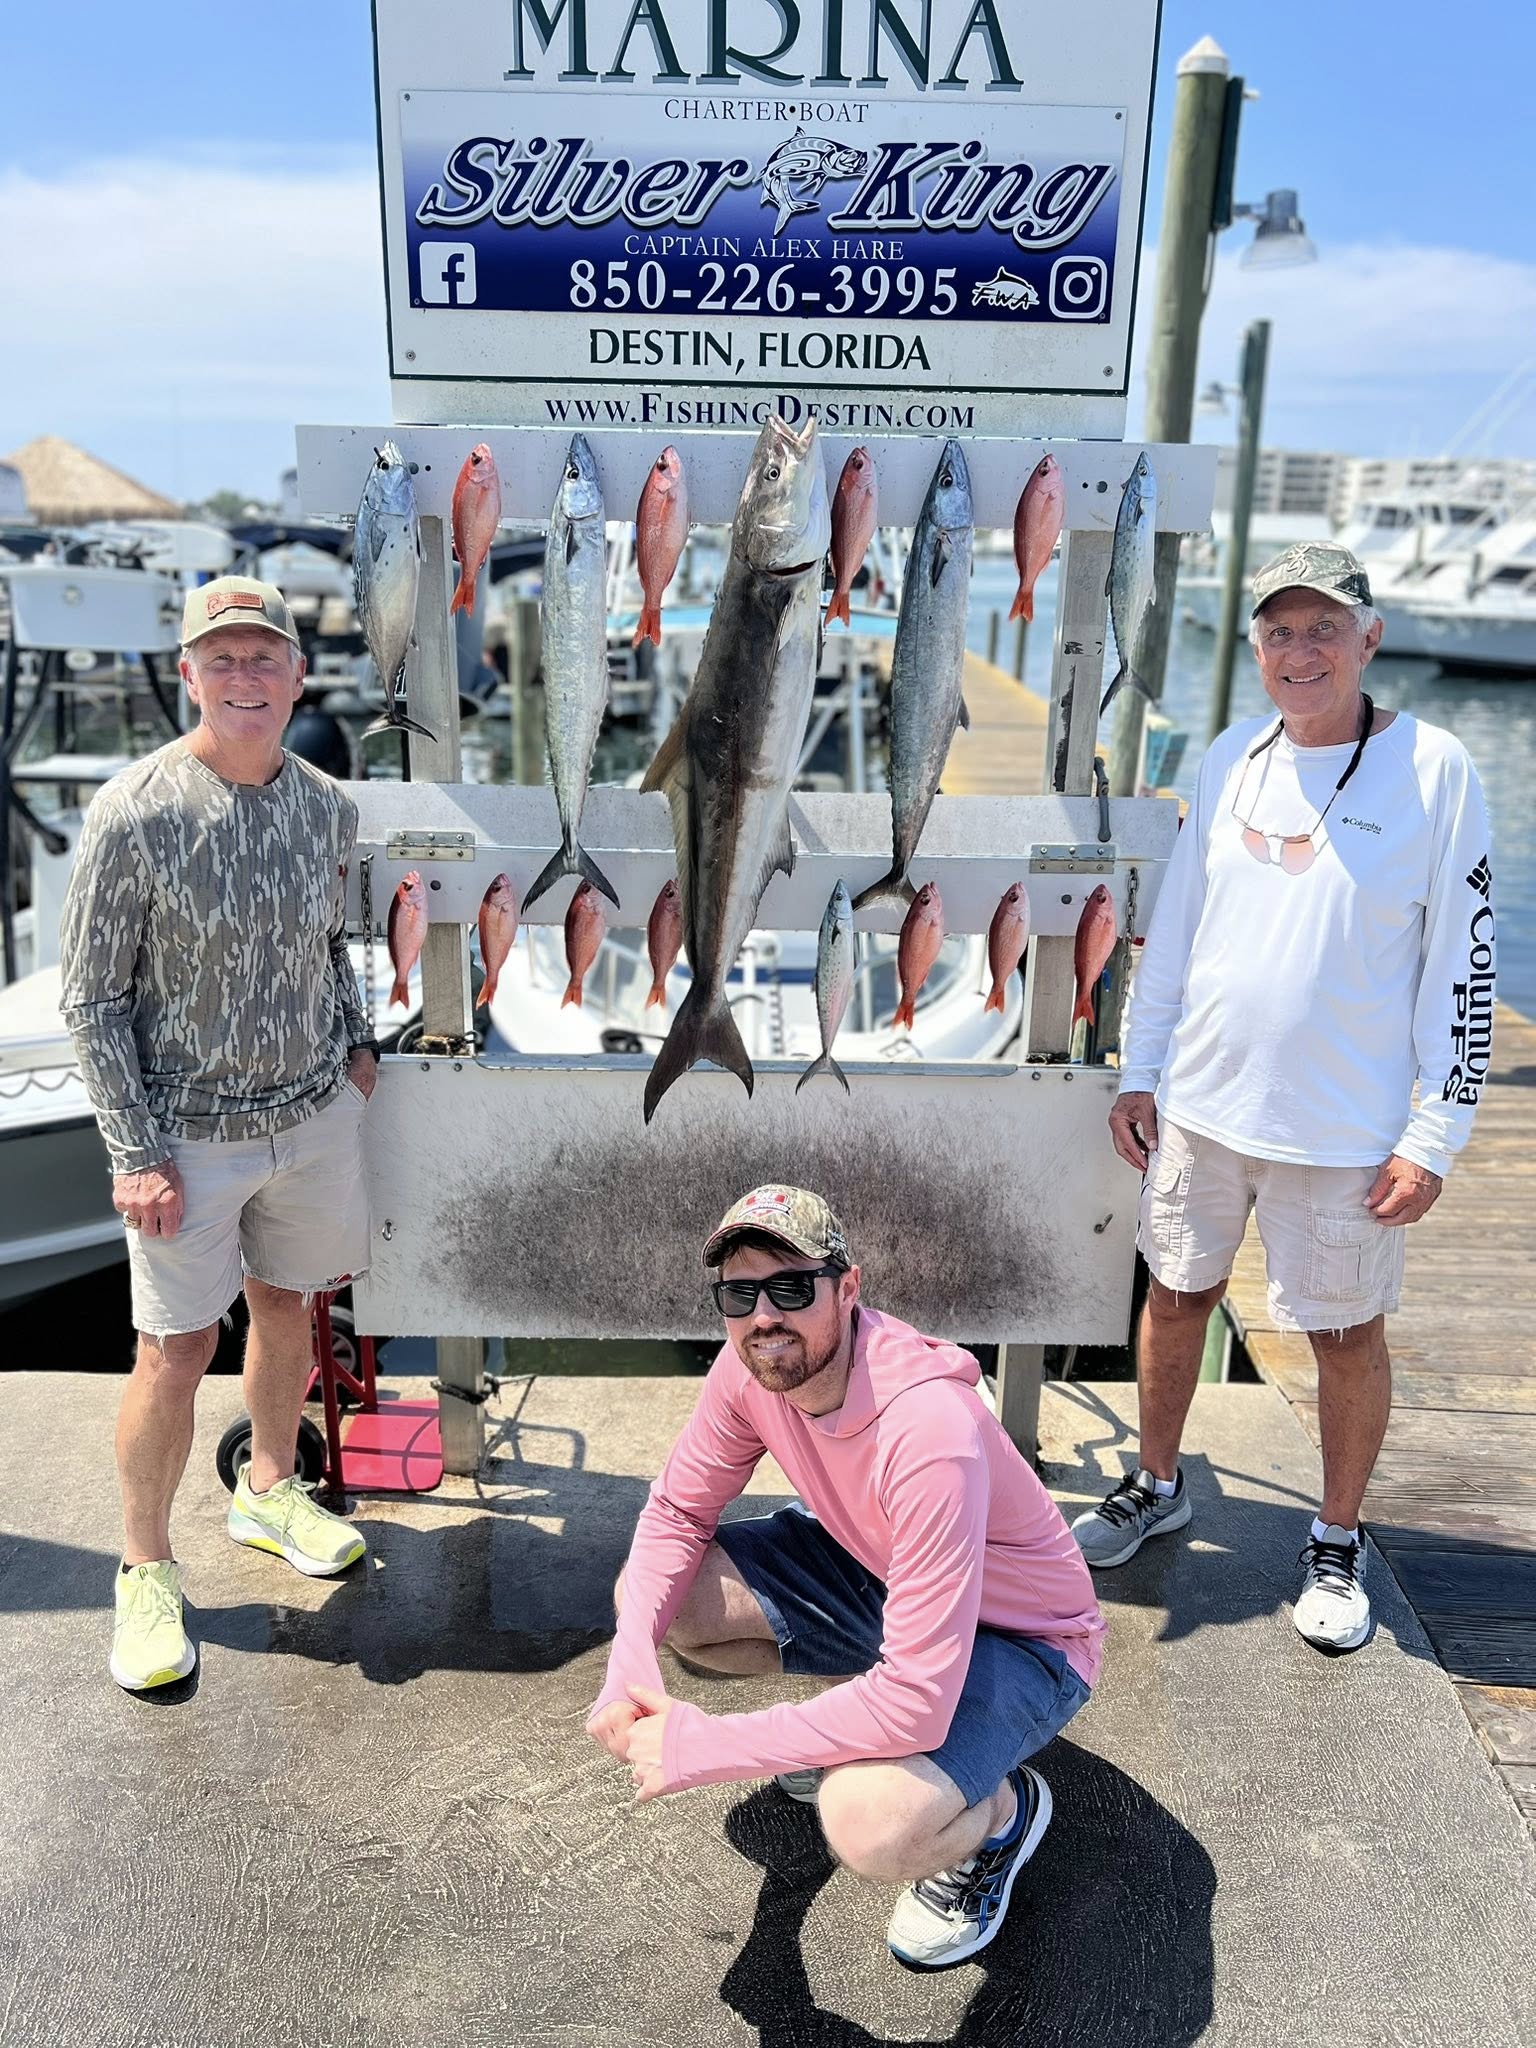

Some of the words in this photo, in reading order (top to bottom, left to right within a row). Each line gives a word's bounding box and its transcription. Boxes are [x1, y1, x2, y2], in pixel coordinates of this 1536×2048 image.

[503, 0, 1024, 91] MARINA
[415, 136, 754, 226] Silver
[827, 140, 1117, 249] King
[569, 259, 957, 316] 850-226-3995
[624, 235, 740, 257] CAPTAIN
[752, 237, 822, 259] ALEX
[831, 239, 904, 261] HARE
[589, 328, 745, 375] DESTIN,
[758, 332, 932, 371] FLORIDA
[1442, 982, 1468, 1102] PFG
[1456, 905, 1497, 1105] Columbia
